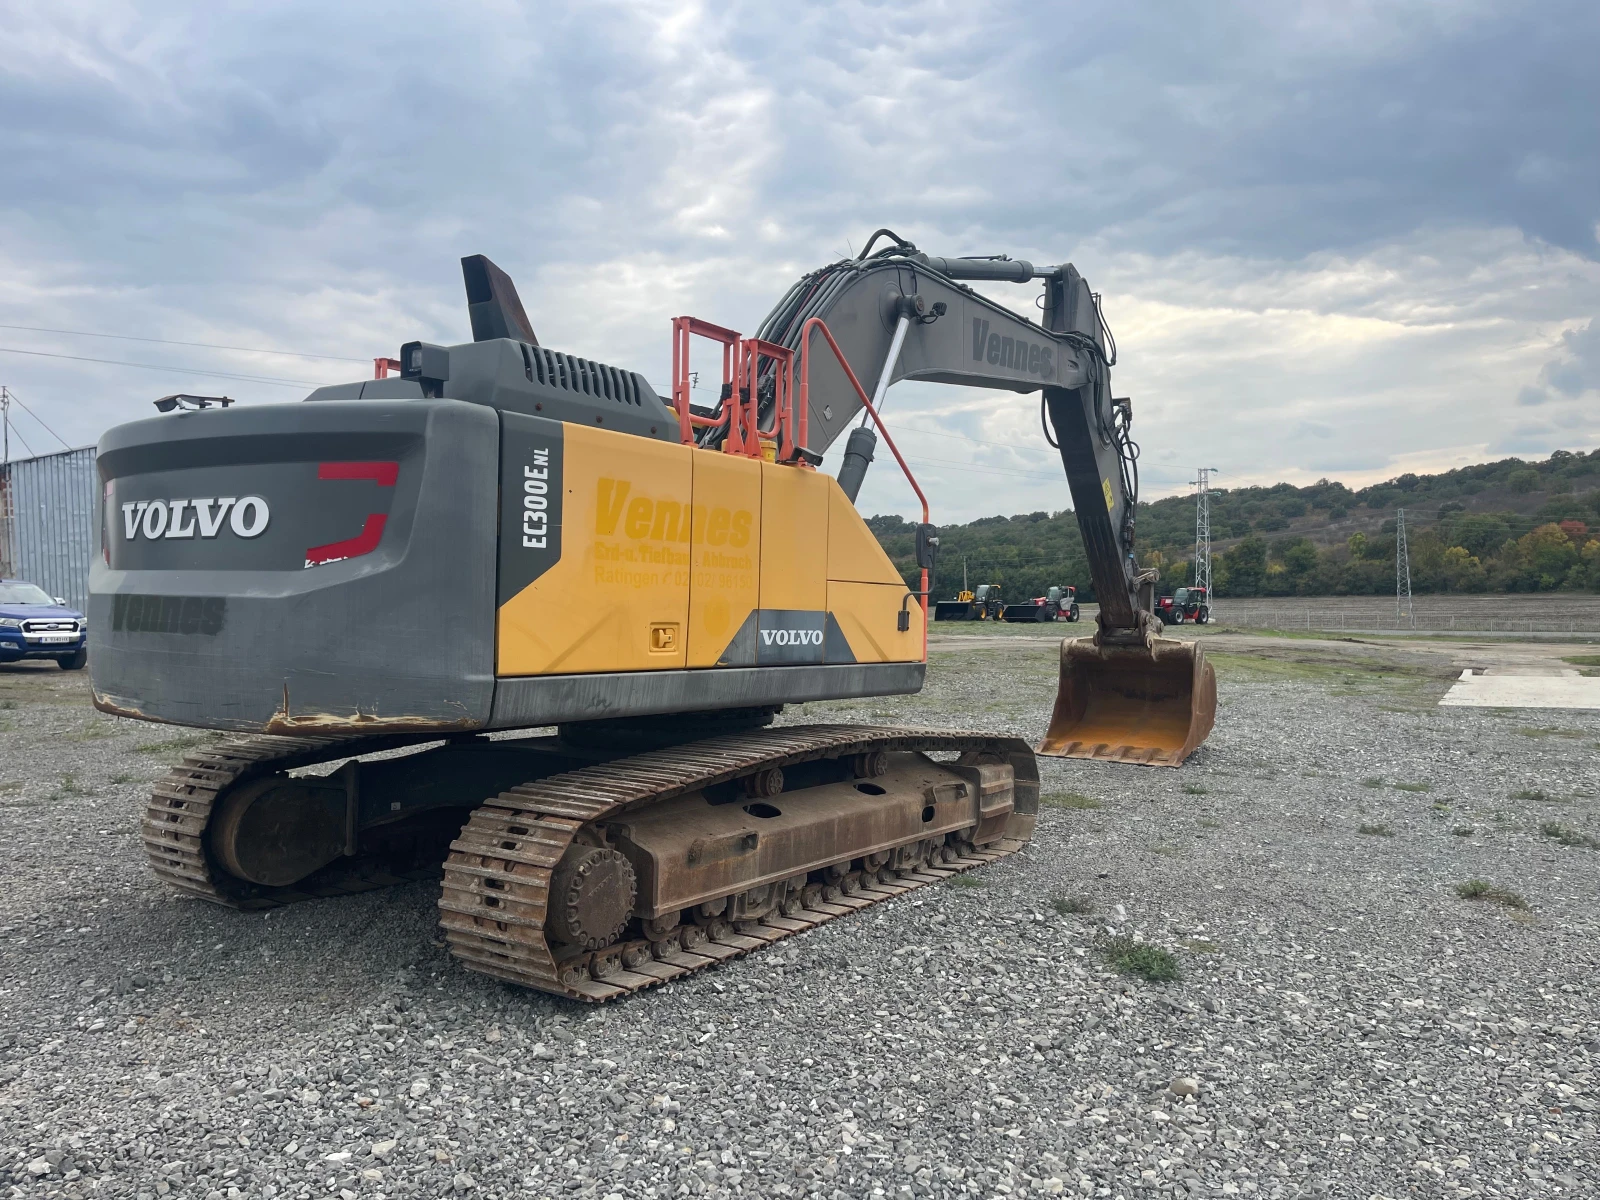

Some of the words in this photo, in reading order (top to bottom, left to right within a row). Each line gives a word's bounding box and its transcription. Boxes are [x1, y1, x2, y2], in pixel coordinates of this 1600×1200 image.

[973, 318, 1052, 377] Vennes
[121, 495, 270, 540] VOLVO
[595, 477, 753, 548] Vennes
[594, 566, 659, 588] Ratingen
[703, 551, 752, 571] Abbruch
[112, 597, 227, 635] Vennes
[760, 629, 823, 645] VOLVO
